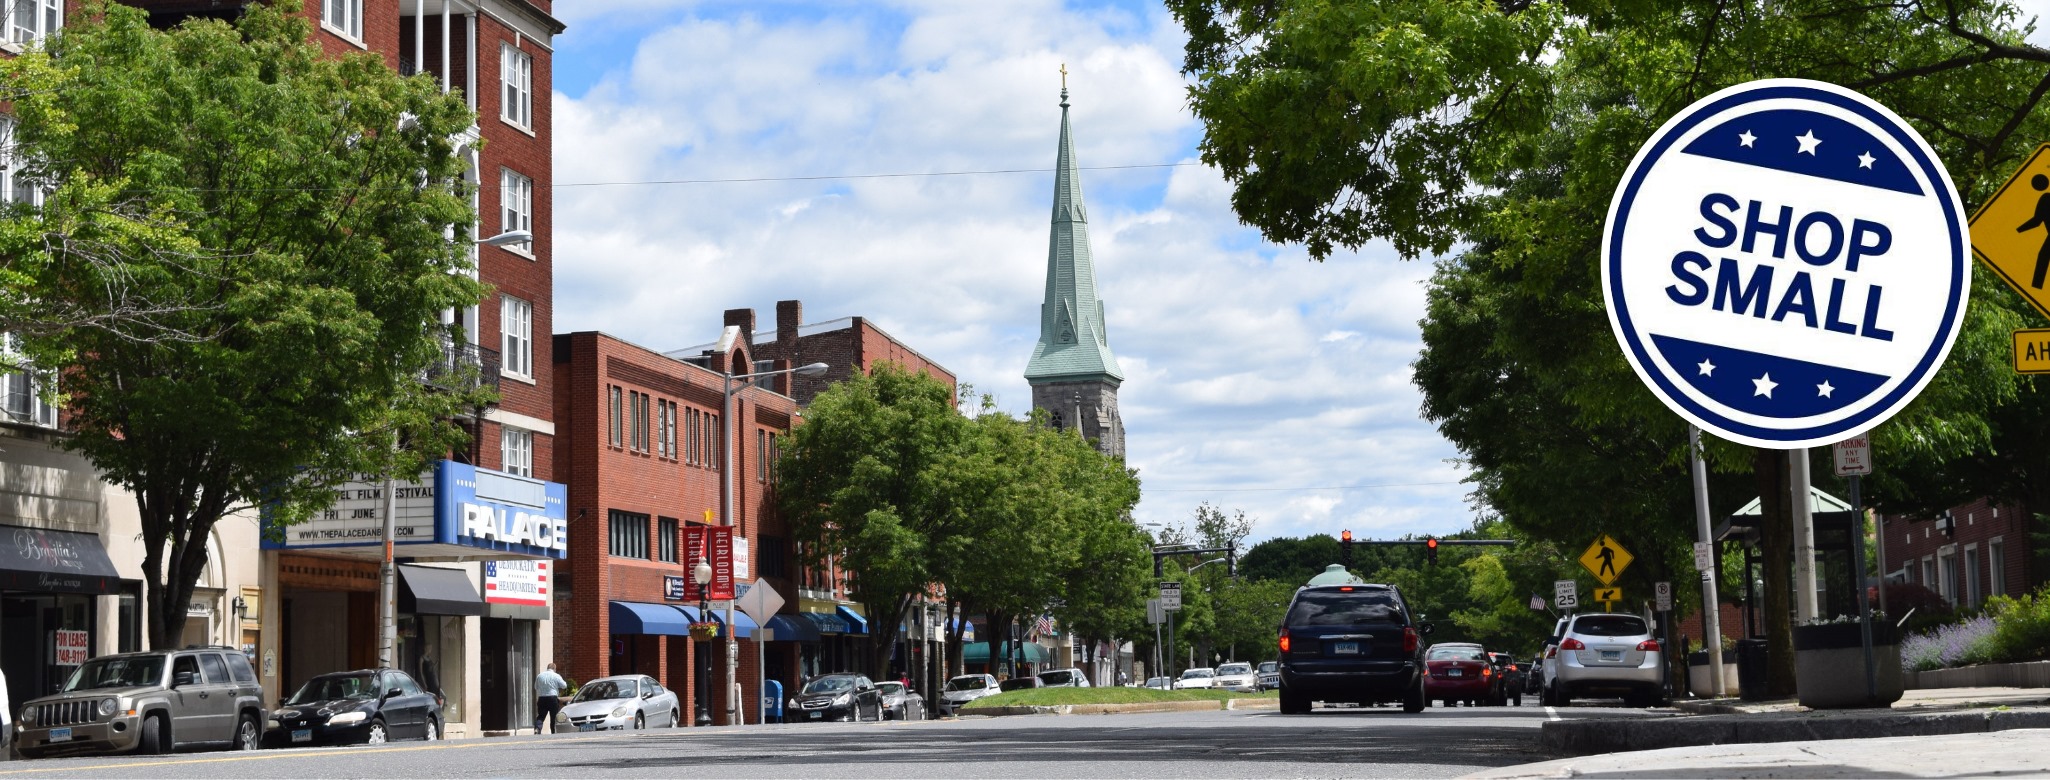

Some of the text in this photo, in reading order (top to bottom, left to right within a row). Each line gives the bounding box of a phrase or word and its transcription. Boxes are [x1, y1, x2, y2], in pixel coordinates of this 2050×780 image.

[1836, 439, 1867, 449] PARKING
[357, 489, 381, 499] FILM
[395, 487, 434, 499] ESTIVAL
[324, 508, 375, 520] FRI JUNE
[457, 502, 567, 551] PALACE
[299, 527, 414, 539] WWW.THEPALACEDANB.COM
[716, 531, 730, 584] HEIRLOOM
[498, 580, 537, 594] HEADQUARTERS
[1558, 595, 1576, 606] 25
[69, 632, 87, 648] LEASE
